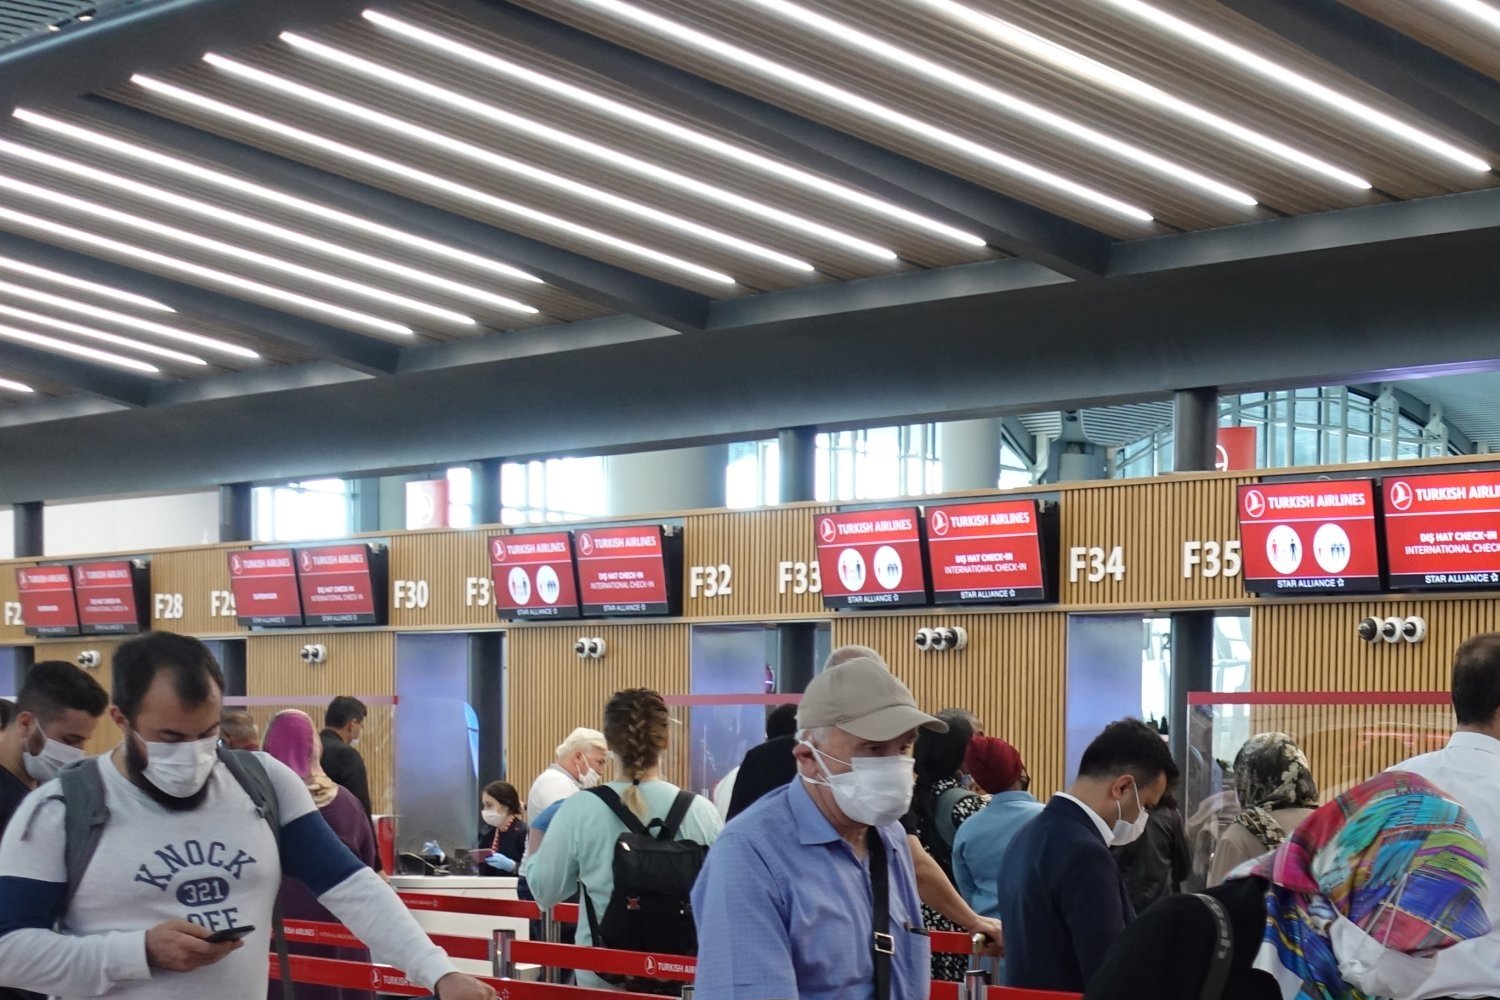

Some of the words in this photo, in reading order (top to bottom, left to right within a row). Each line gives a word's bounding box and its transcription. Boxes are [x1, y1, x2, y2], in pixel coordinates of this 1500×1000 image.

[1267, 496, 1314, 510] TURKISH
[1316, 493, 1366, 507] AIRLINES
[1415, 486, 1467, 502] TURKISH
[838, 522, 874, 535] TURKISH
[874, 518, 912, 532] AIRLINES
[950, 515, 988, 529] TURKISH
[989, 512, 1030, 525] AIRLINES
[1435, 533, 1454, 543] HAT
[1455, 531, 1497, 542] CHECK-IN
[1183, 540, 1242, 579] F35
[1405, 544, 1472, 555] INTERNATIONAL
[1070, 545, 1126, 583] F34
[690, 564, 732, 598] F32
[778, 560, 822, 594] F33
[1277, 580, 1297, 588] STAR
[1298, 578, 1336, 588] ALLIANCE
[1425, 574, 1446, 583] STAR
[1447, 573, 1489, 583] ALLIANCE
[394, 580, 429, 609] F30
[960, 591, 976, 599] STAR
[977, 589, 1009, 598] ALLIANCE
[4, 601, 25, 626] F2
[155, 593, 183, 619] F28
[134, 839, 256, 892] KNOCK
[183, 880, 225, 904] 321
